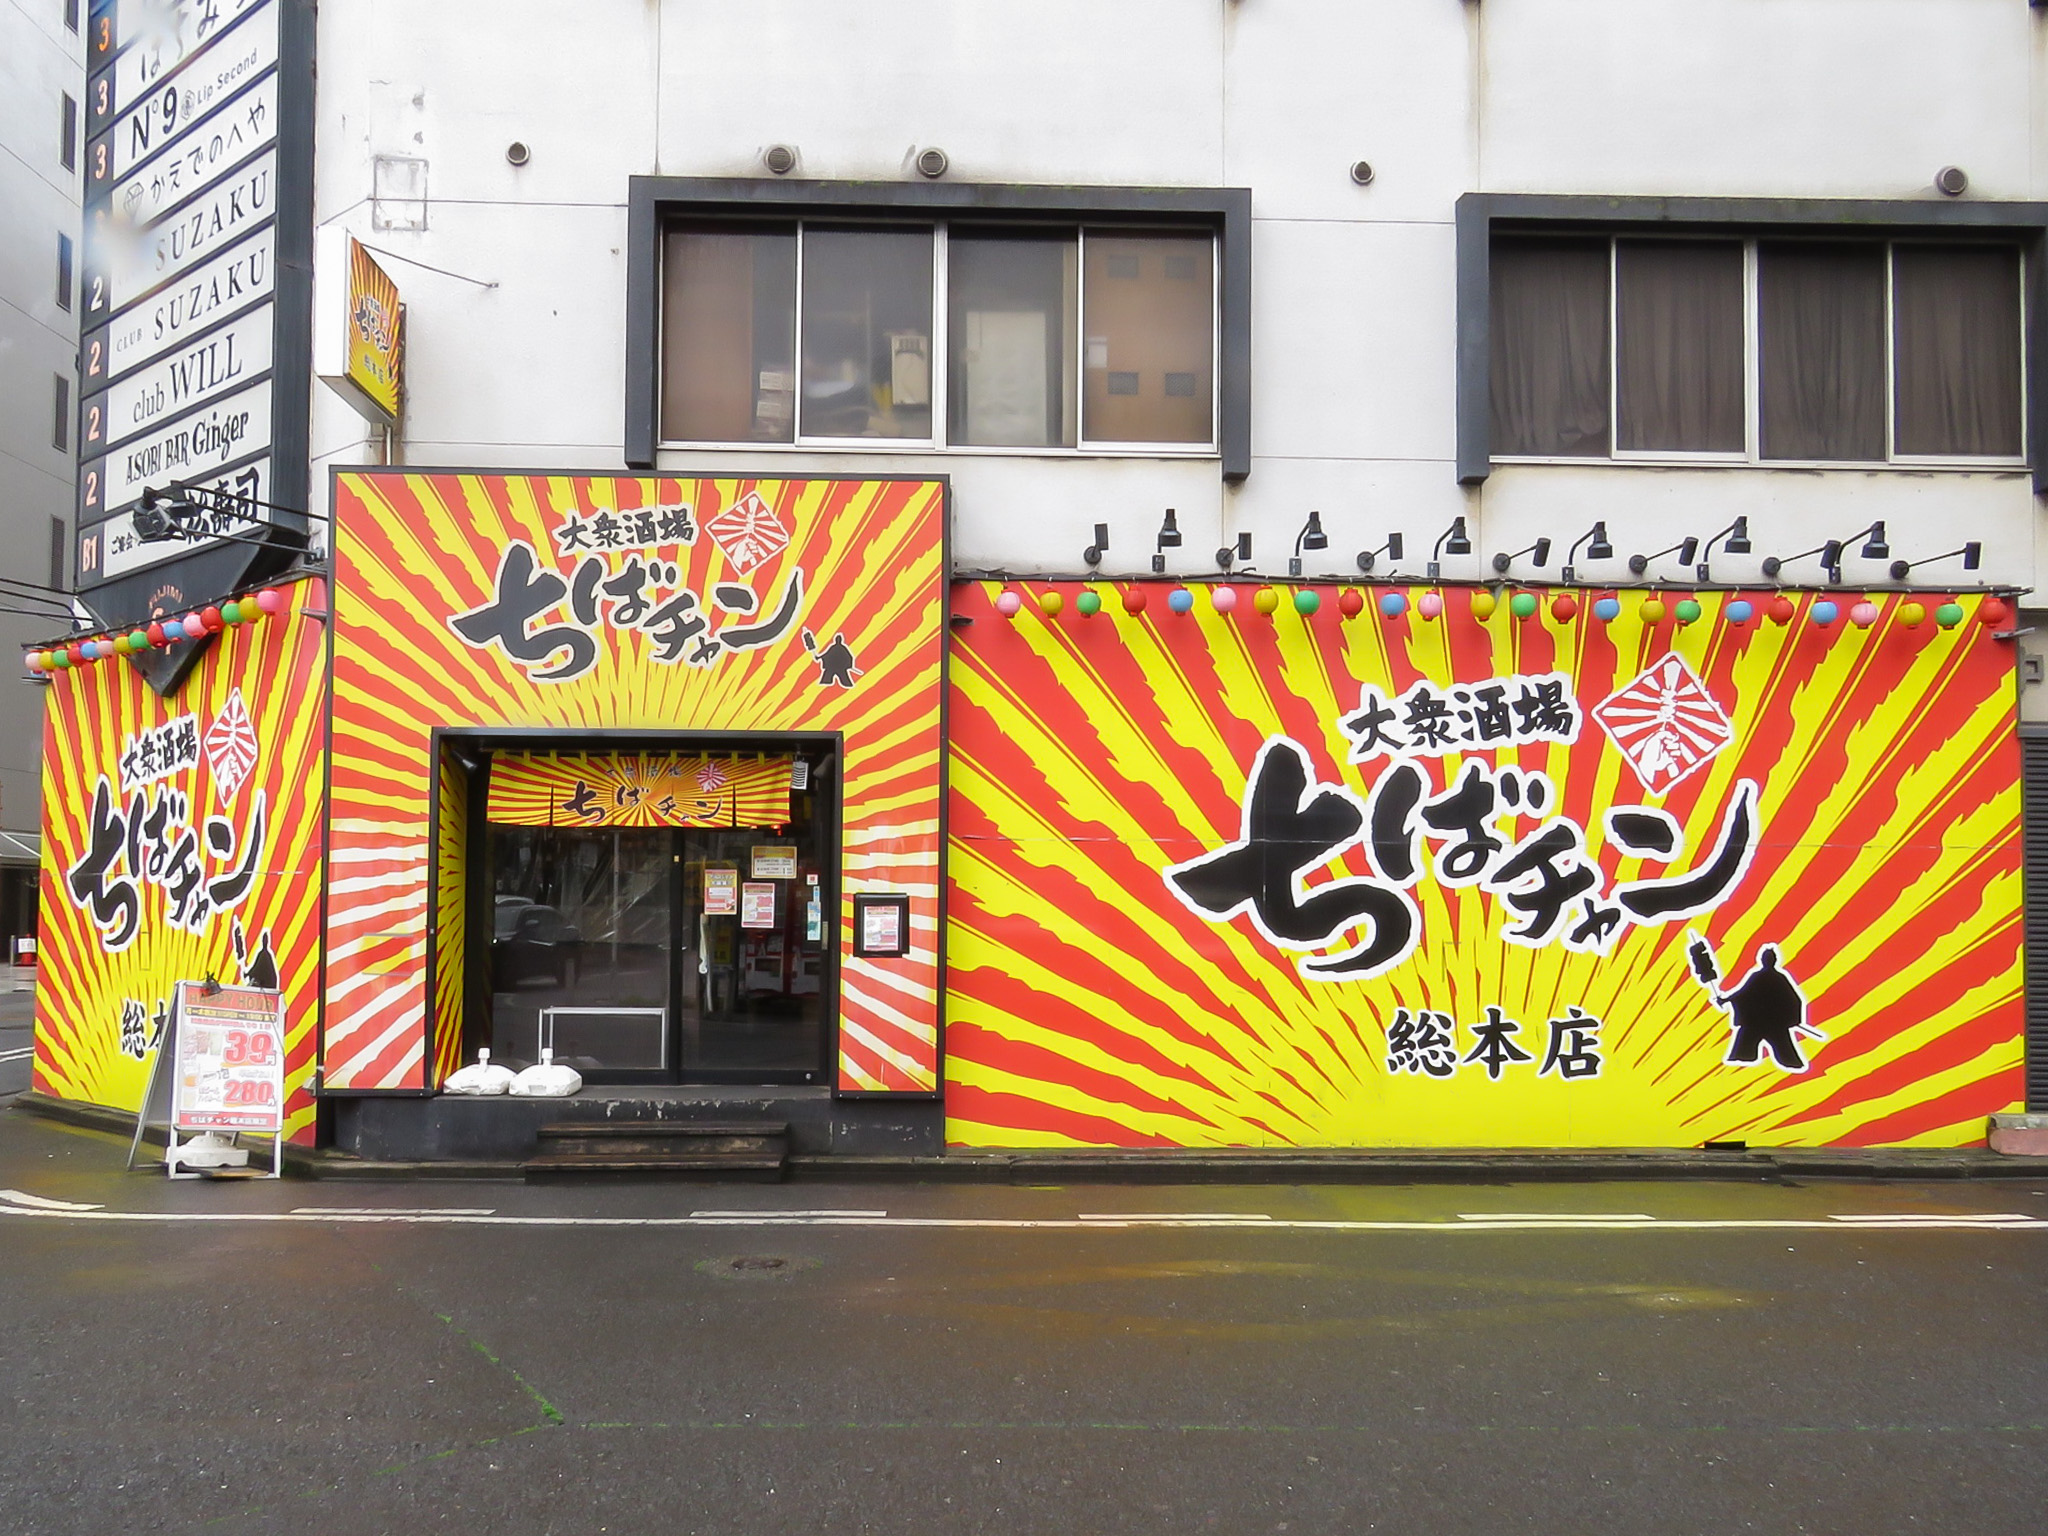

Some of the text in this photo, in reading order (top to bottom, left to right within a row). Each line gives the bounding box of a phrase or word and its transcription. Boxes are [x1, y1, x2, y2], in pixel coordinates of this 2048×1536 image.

[99, 17, 110, 51] 3
[97, 79, 108, 115] 3
[197, 84, 213, 105] Lip
[217, 48, 257, 90] Second
[95, 143, 107, 179] 3
[155, 170, 268, 271] SUZAKU
[91, 276, 103, 312] 2
[154, 247, 266, 340] SUZAKU
[88, 341, 101, 376] 2
[133, 332, 242, 423] club WILL
[88, 406, 100, 441] 2
[126, 411, 249, 485] ASOBI BAR Ginger
[86, 472, 97, 506] 2
[82, 535, 98, 573] B1
[559, 507, 693, 551] 大衆酒場
[450, 544, 800, 679] ちばチャン
[1350, 682, 1573, 755] 大衆酒場
[123, 719, 199, 785] 大衆酒場
[562, 780, 723, 823] ちばチャン
[69, 779, 263, 947] ちばチャン
[1172, 743, 1750, 973] ちばチャン
[1387, 1008, 1603, 1080] 総本店
